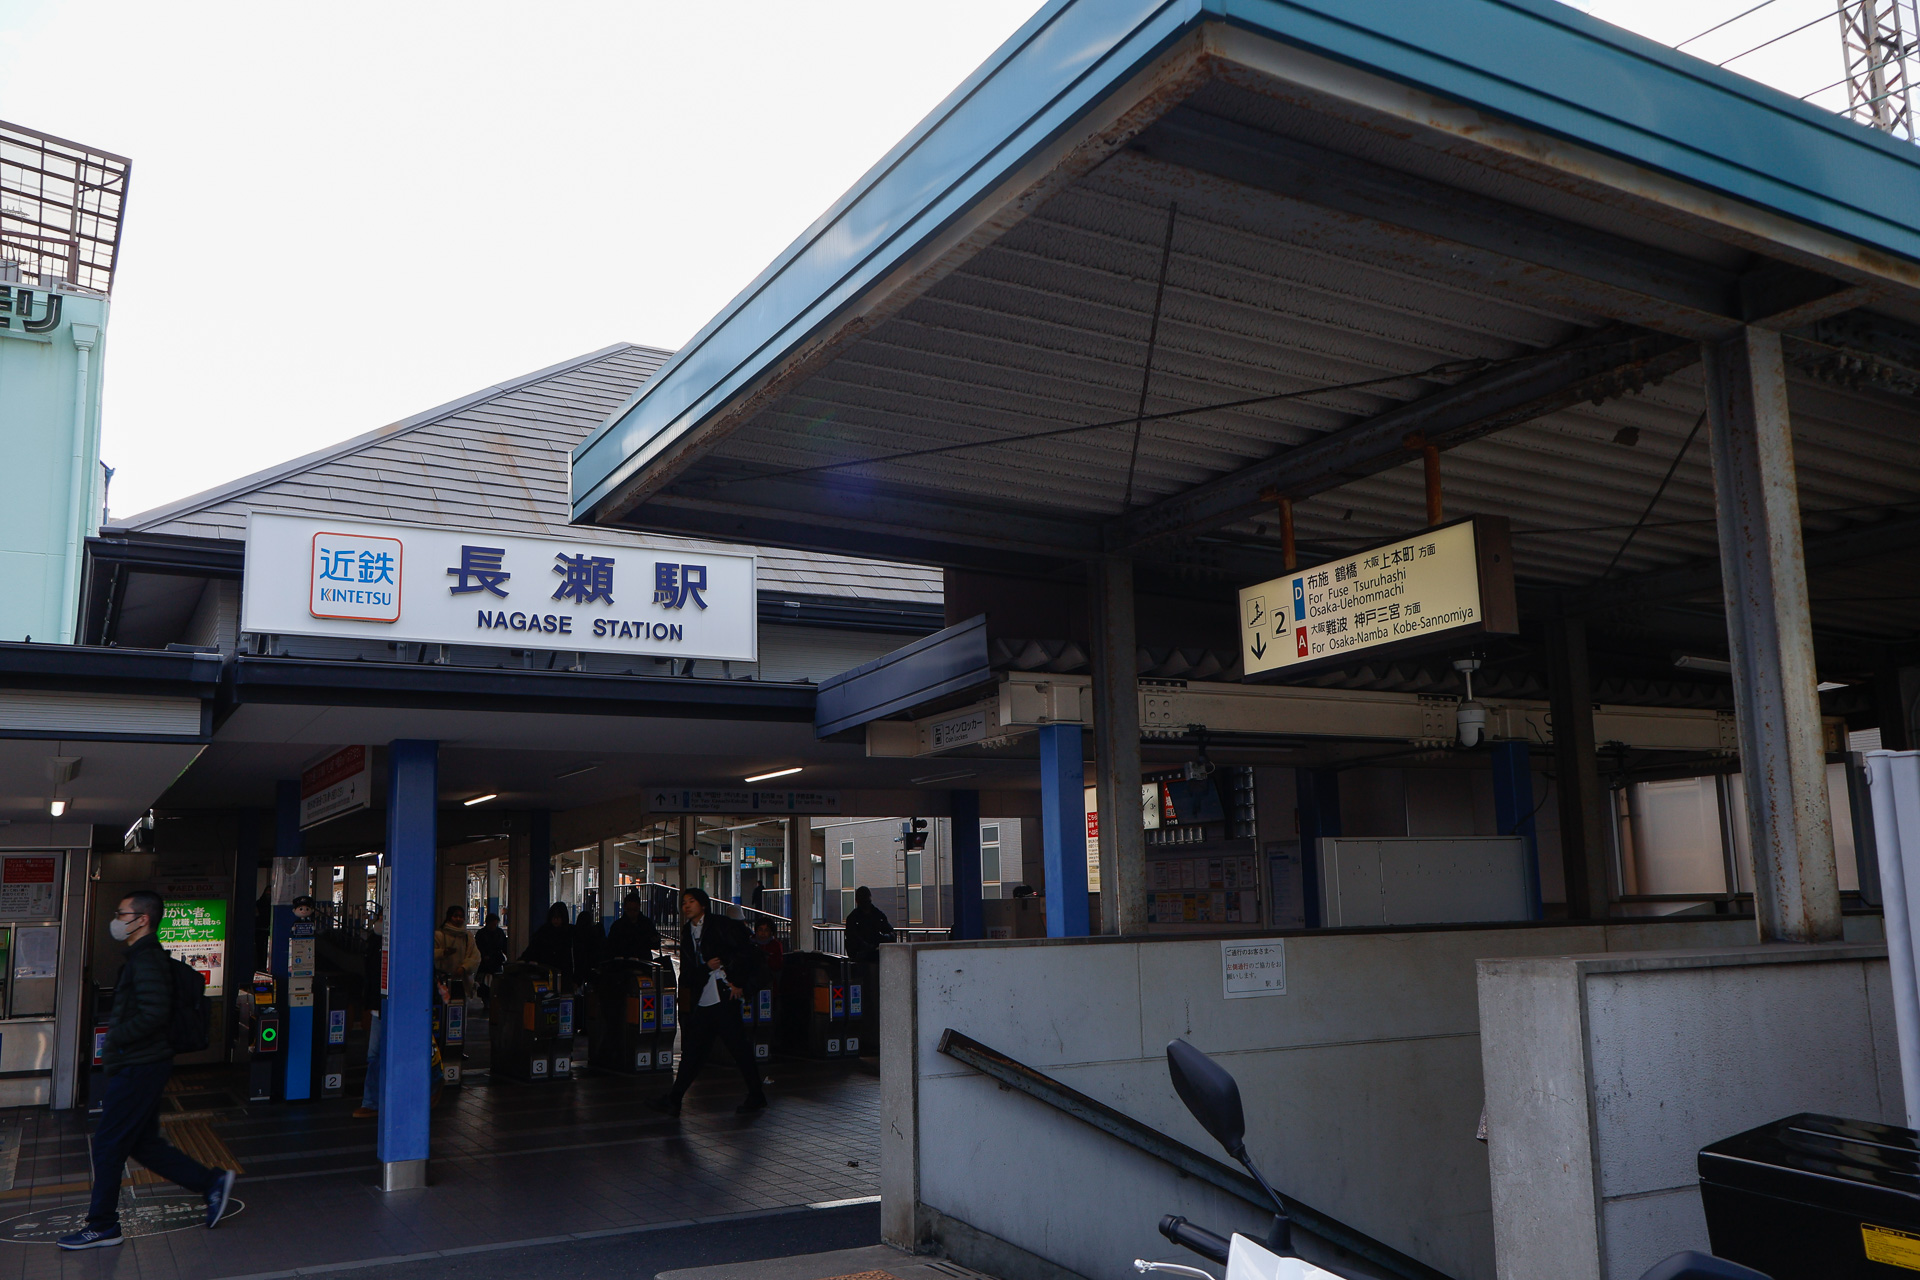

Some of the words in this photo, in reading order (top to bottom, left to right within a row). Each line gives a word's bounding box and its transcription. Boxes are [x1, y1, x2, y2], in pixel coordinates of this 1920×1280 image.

[319, 547, 394, 585] 近鉄
[1307, 571, 1330, 590] 布施
[1334, 562, 1358, 583] 鶴橋
[1418, 543, 1436, 559] 方面
[446, 545, 709, 611] 長瀬駅
[1308, 590, 1324, 605] For
[1328, 586, 1349, 601] Fuse
[1353, 567, 1407, 593] Tsuruhashi
[320, 587, 392, 606] KINTETSU
[1294, 586, 1303, 601] D
[1309, 581, 1405, 618] Osaka-Uehommachi
[1354, 603, 1401, 629] 神戸三宮
[1403, 601, 1421, 617] 方面
[476, 609, 573, 634] NAGASE
[593, 618, 684, 642] STATION
[1274, 611, 1287, 635] 2
[1311, 641, 1325, 655] For
[1329, 625, 1389, 650] Osaka-Namba
[1392, 606, 1474, 636] Kobe-Sannomiya
[1298, 636, 1307, 649] A
[945, 718, 983, 735] コインロッカー
[160, 929, 214, 939] クローバーナビ
[1226, 948, 1275, 957] ご通行のお客さまへ
[1226, 961, 1282, 970] 左側通行のご協力をお
[759, 1046, 765, 1055] 6
[831, 1041, 837, 1050] 6
[850, 1041, 855, 1049] 7
[557, 1059, 565, 1070] 4
[640, 1055, 647, 1064] 4
[662, 1053, 668, 1063] 5
[537, 1062, 543, 1071] 3
[448, 1069, 455, 1079] 3
[328, 1076, 337, 1086] 2
